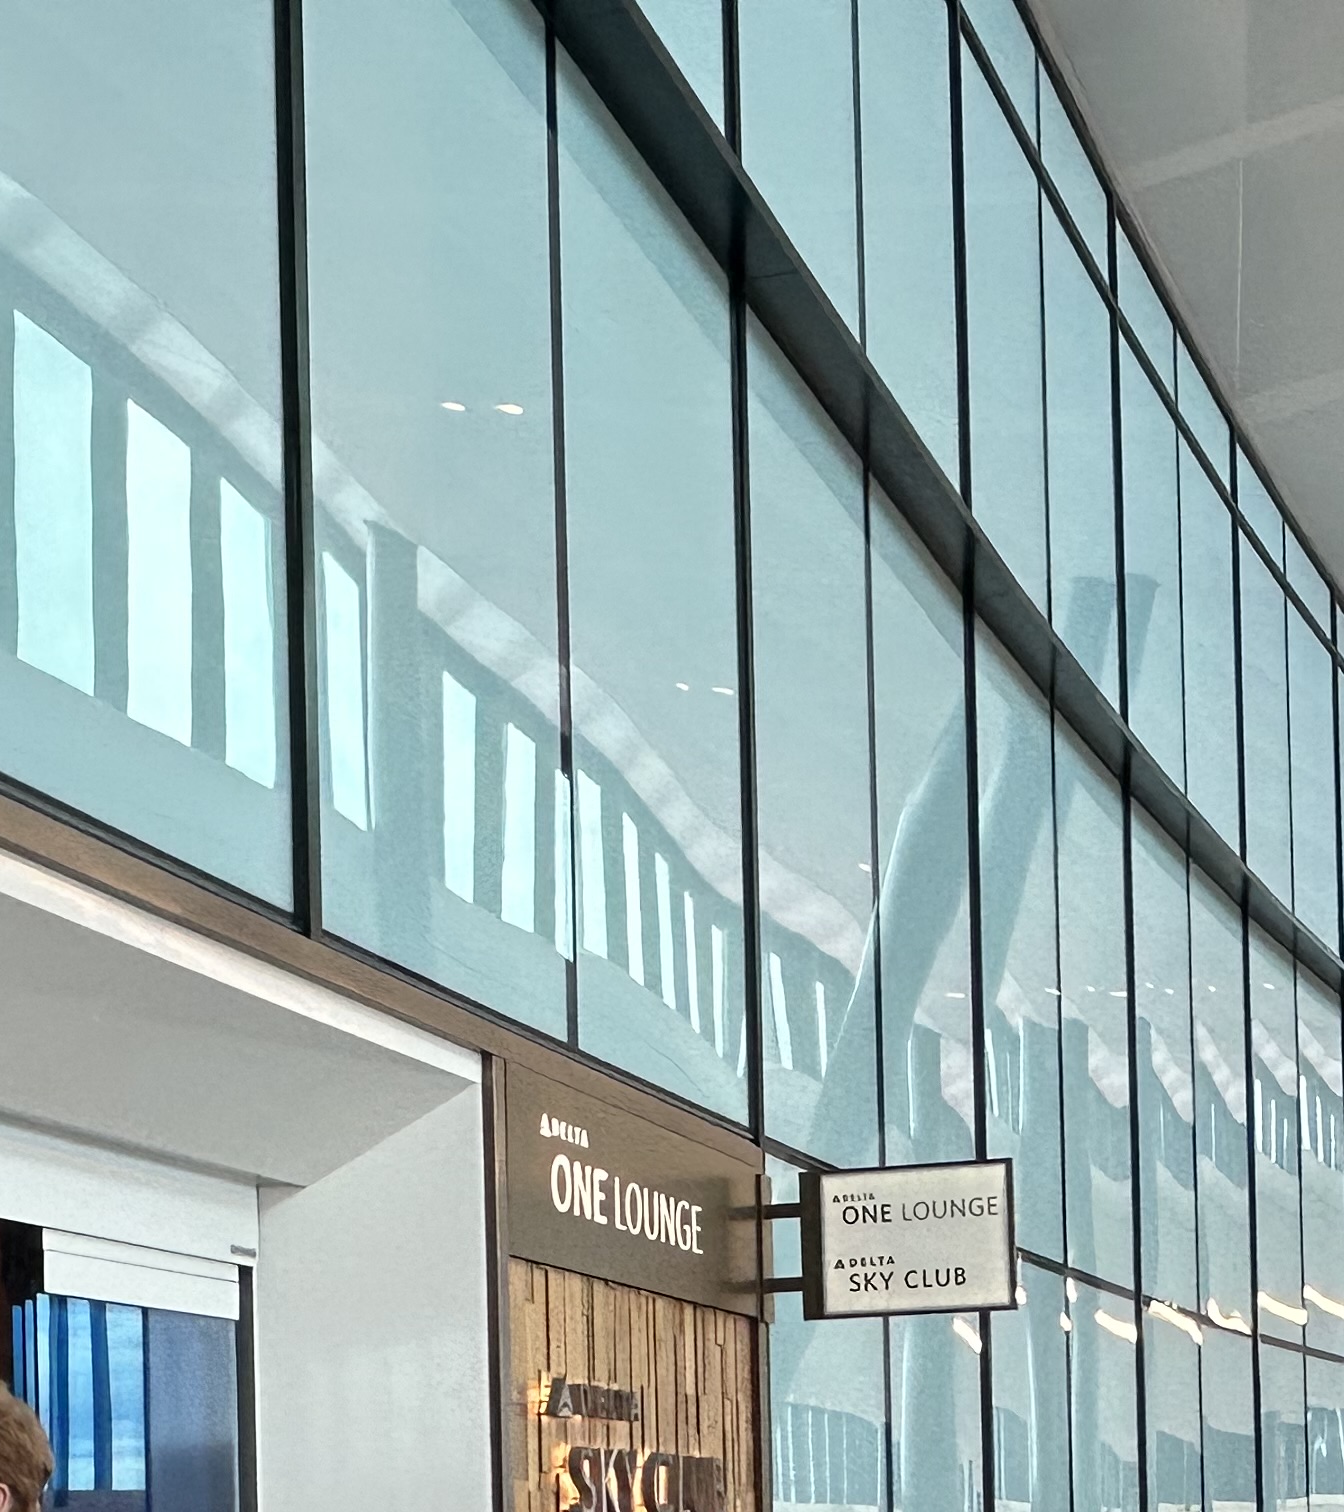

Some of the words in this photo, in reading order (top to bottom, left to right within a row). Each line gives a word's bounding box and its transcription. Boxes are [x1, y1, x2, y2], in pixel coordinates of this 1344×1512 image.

[551, 1116, 590, 1149] DELTA
[550, 1153, 609, 1225] ONE
[613, 1176, 704, 1255] LOUNGE
[842, 1192, 876, 1203] DELTA
[842, 1203, 893, 1225] ONE
[901, 1195, 999, 1222] LOUNGE
[849, 1255, 896, 1269] DELTA
[849, 1271, 895, 1293] SKY
[903, 1267, 968, 1290] CLUB
